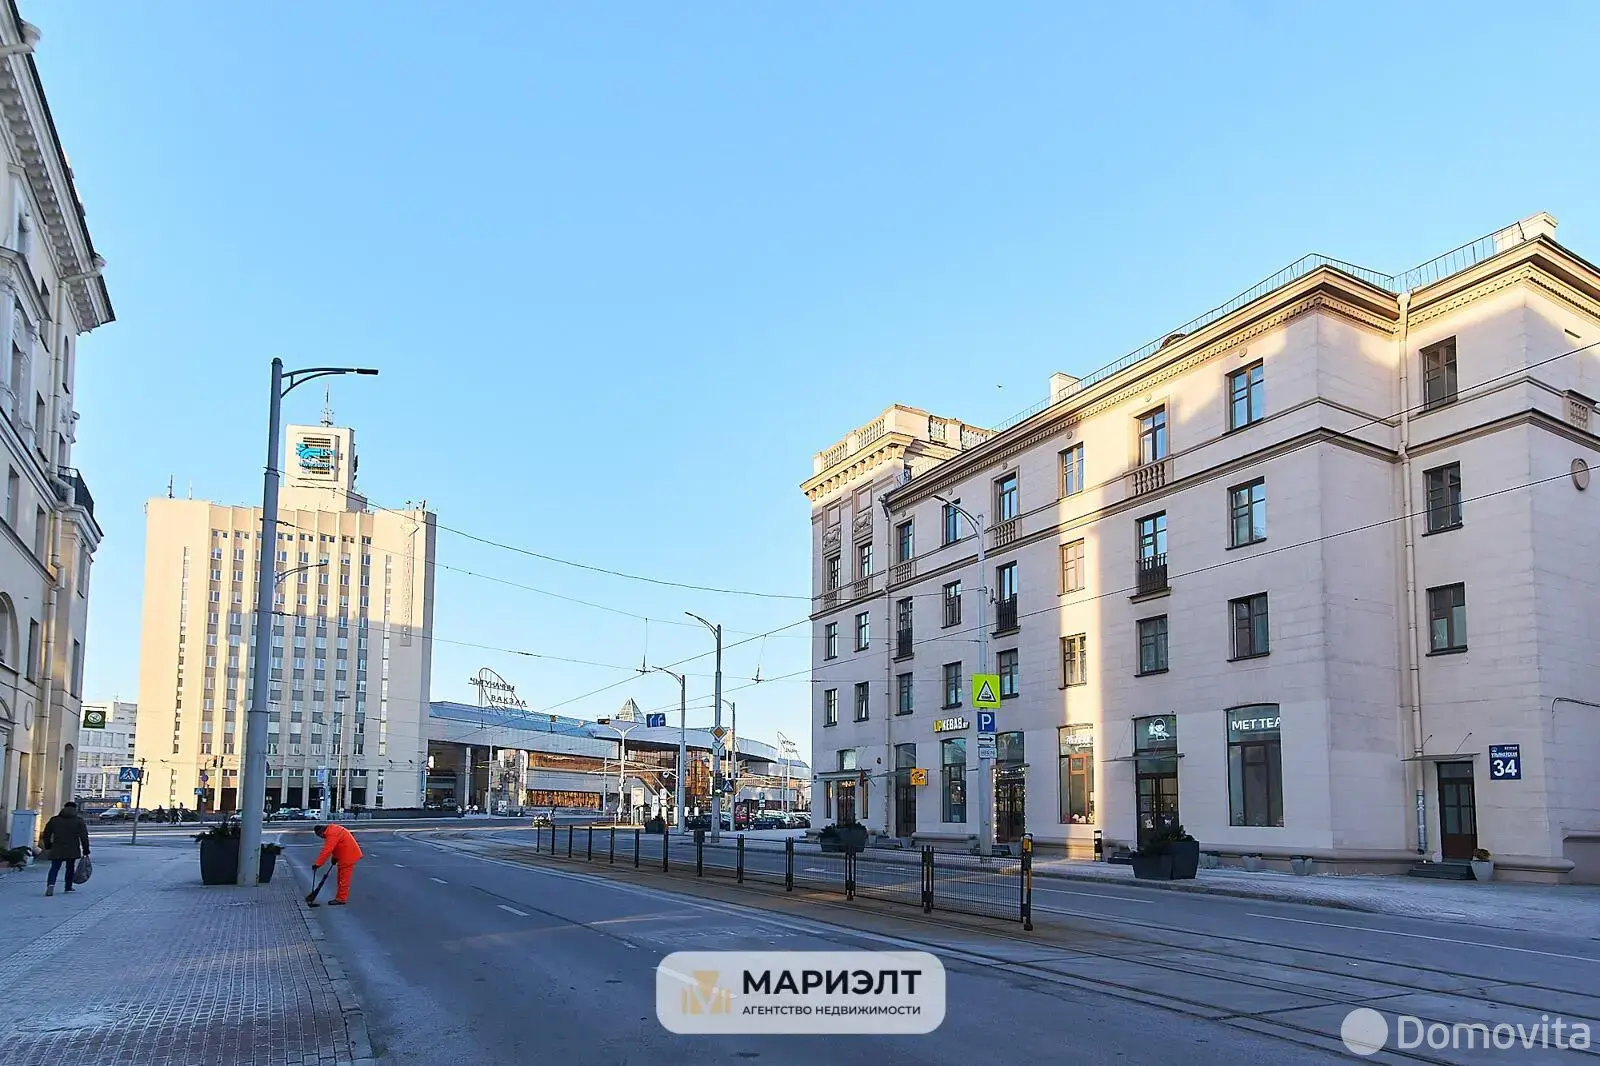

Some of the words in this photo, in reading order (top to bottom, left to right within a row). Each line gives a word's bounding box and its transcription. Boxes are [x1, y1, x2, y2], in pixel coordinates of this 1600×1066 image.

[981, 714, 992, 730] P
[1232, 718, 1257, 730] MET
[1493, 759, 1517, 776] 34
